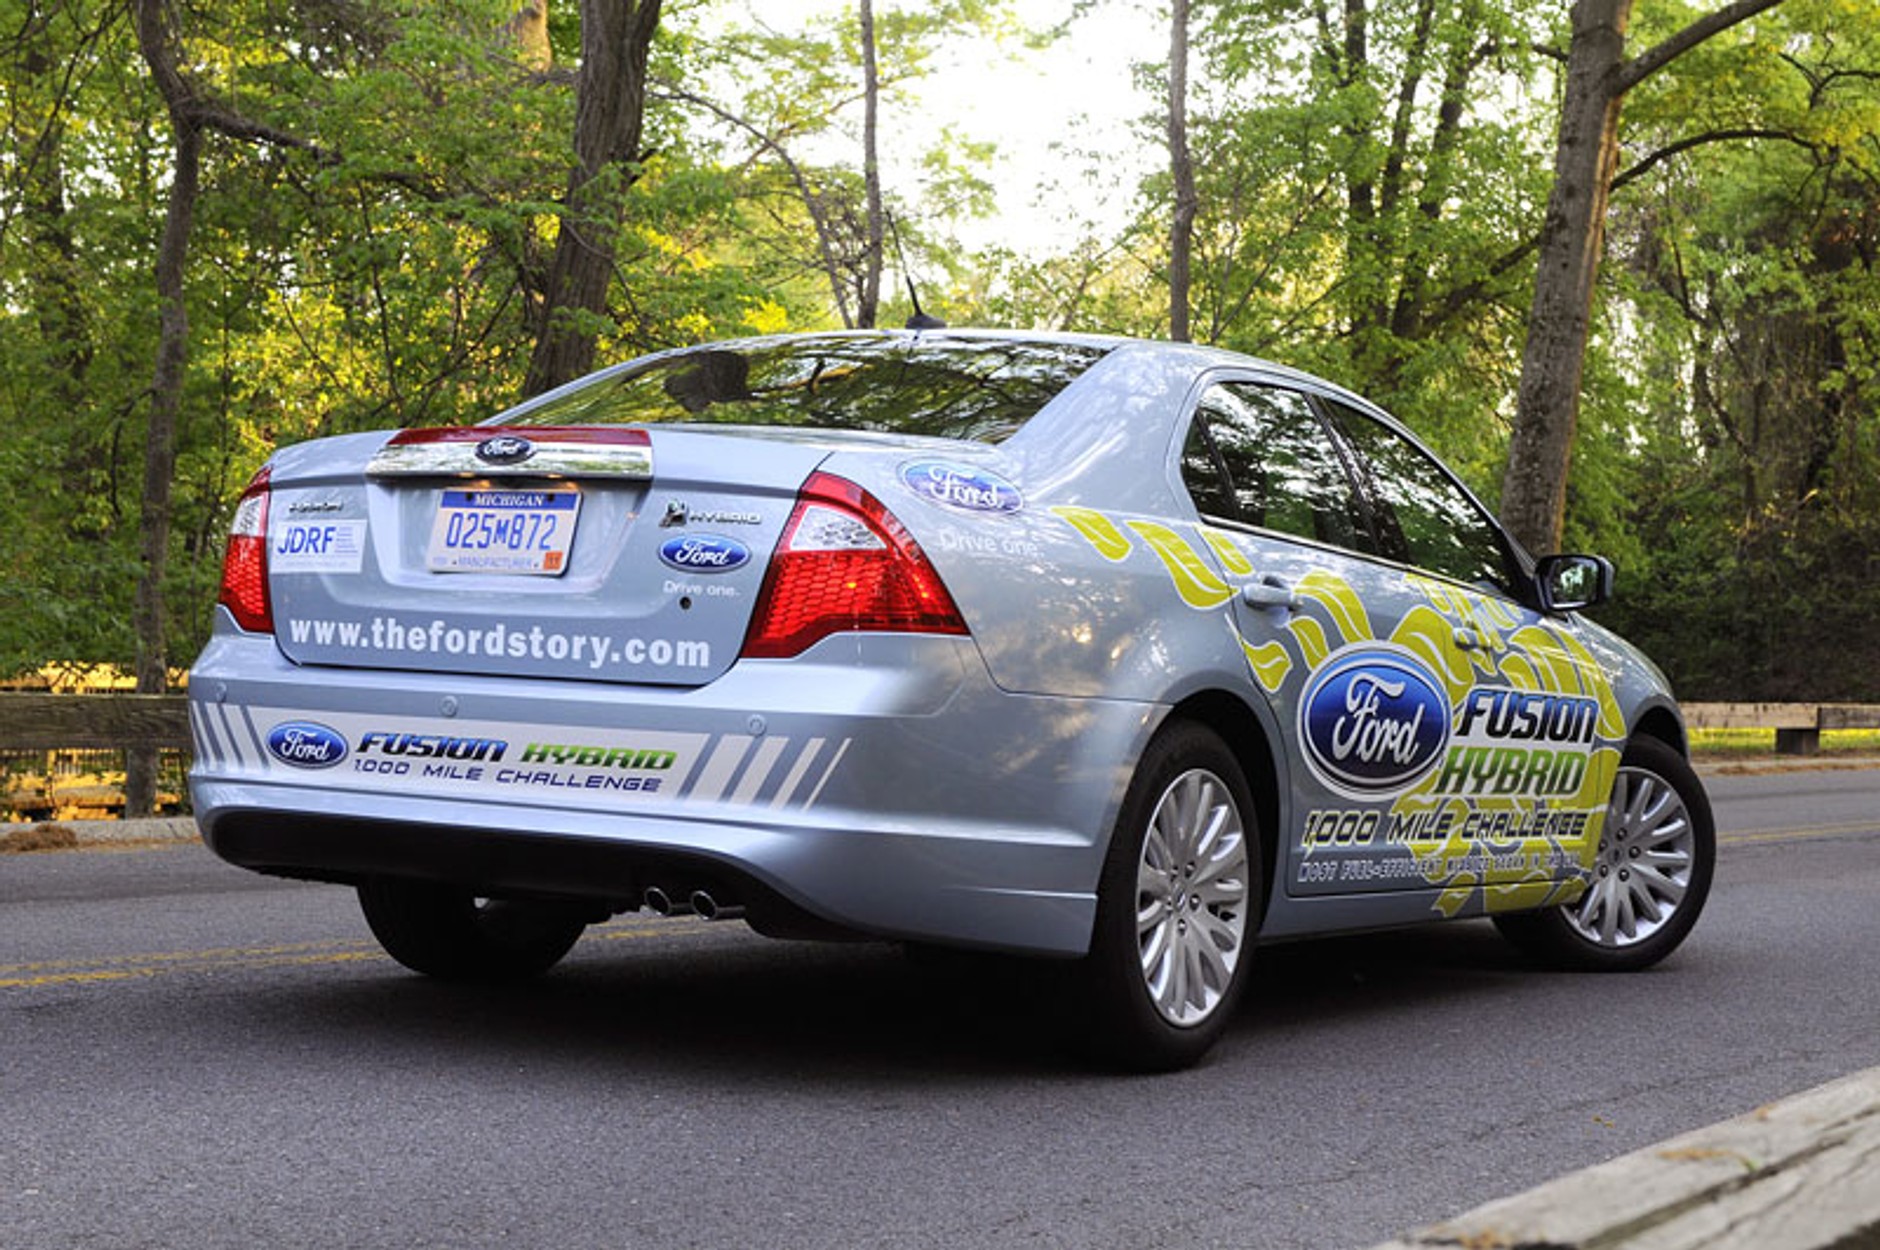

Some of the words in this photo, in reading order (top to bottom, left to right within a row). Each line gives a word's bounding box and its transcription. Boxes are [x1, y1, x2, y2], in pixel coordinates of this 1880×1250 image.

[473, 493, 545, 507] MICHIGAN
[928, 465, 1005, 508] Ford
[277, 526, 336, 554] JDRF
[446, 512, 557, 550] 025M872
[940, 526, 997, 551] Drive
[675, 540, 733, 565] Ford
[663, 580, 702, 596] Drive
[706, 584, 740, 597] one.
[290, 617, 711, 668] www.thefordstory.com
[1332, 672, 1425, 765] Ford
[1455, 688, 1599, 744] FUSION
[281, 729, 330, 761] Ford
[355, 731, 508, 763] FUSION
[521, 743, 677, 769] HYBRID
[423, 763, 483, 782] MILE
[496, 769, 662, 793] CHALLENGE
[1433, 746, 1589, 796] HYBRID
[1387, 811, 1457, 844] MILE
[1461, 810, 1588, 841] CHALLENGE
